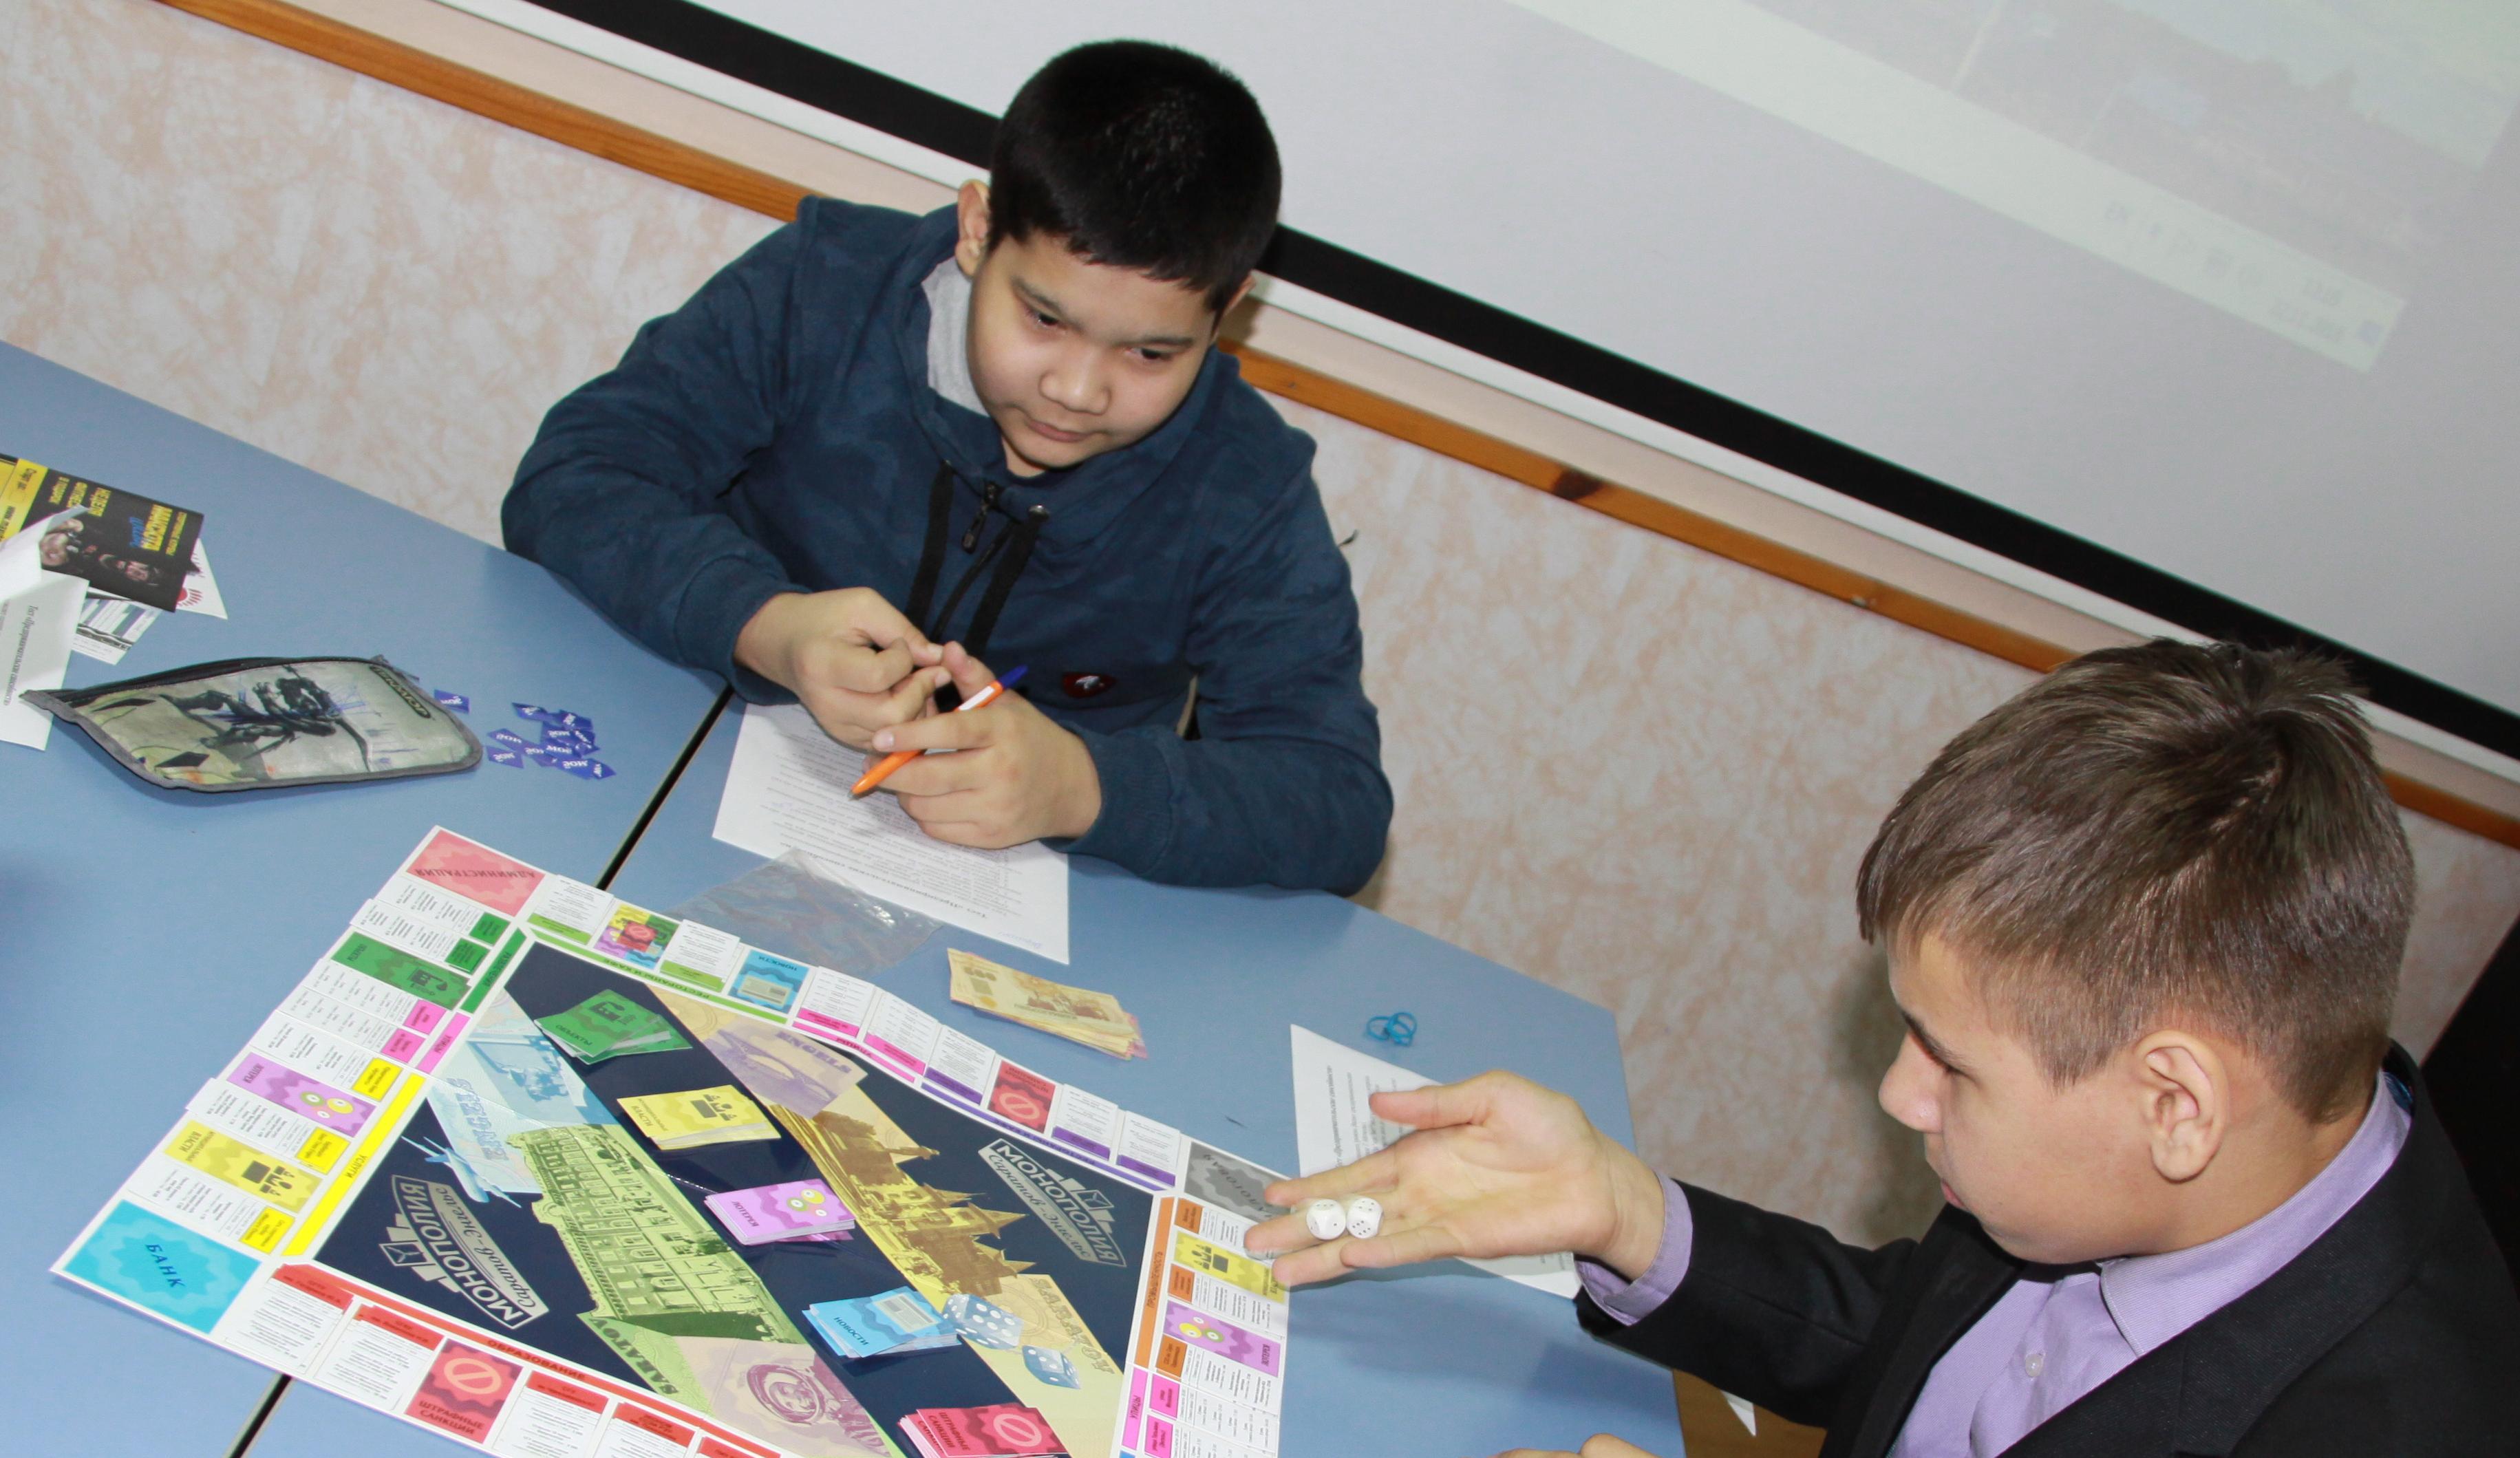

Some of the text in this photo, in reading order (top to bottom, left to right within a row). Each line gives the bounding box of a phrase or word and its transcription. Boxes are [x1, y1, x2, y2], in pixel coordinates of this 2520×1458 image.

[89, 486, 112, 517] НЕДЕЛЯ
[415, 868, 536, 879] АДМИНИСТРАЦИЯ
[604, 958, 632, 973] КАФЕ
[758, 954, 798, 972] НОВОСТИ
[642, 972, 711, 1000] РЕСТОРАНЫ
[555, 1023, 593, 1047] ОБЪЕКТЫ
[835, 1036, 873, 1058] УЛИЦЫ
[777, 1031, 853, 1074] ENGELS
[244, 1063, 265, 1084] ЛОТЕРЕЯ
[447, 1077, 509, 1161] ENGELS
[632, 1104, 653, 1128] ВЛАСТИ
[179, 1130, 202, 1153] ВЛАСТИ
[345, 1154, 367, 1179] УСЛУГИ
[731, 1201, 760, 1228] ЛОТЕРЕЯ
[988, 1154, 1092, 1261] Саратов-Энгельс
[996, 1145, 1118, 1261] МОНОПОЛИЯ
[403, 1182, 524, 1323] МОНОПОЛИЯ
[434, 1186, 536, 1309] Саратов-Энгельс
[145, 1243, 185, 1289] БАНК
[1146, 1251, 1163, 1309] ПРОМЫШЛЕННОСТЬ
[833, 1316, 870, 1347] НОВОСТИ
[1032, 1276, 1115, 1375] SARATOV
[487, 1339, 586, 1382] ОБРАЗОВАНИЕ
[590, 1317, 679, 1395] SARATOV
[1261, 1344, 1272, 1366] ЛОТЕРЕЯ
[418, 1400, 486, 1430] ШТРАФНЫЕ
[1129, 1395, 1142, 1419] УЛИЦЫ
[420, 1408, 475, 1437] САНКЦИИ
[929, 1415, 957, 1458] САНКЦИИ
[939, 1411, 971, 1452] ШТРАФНЫЕ
